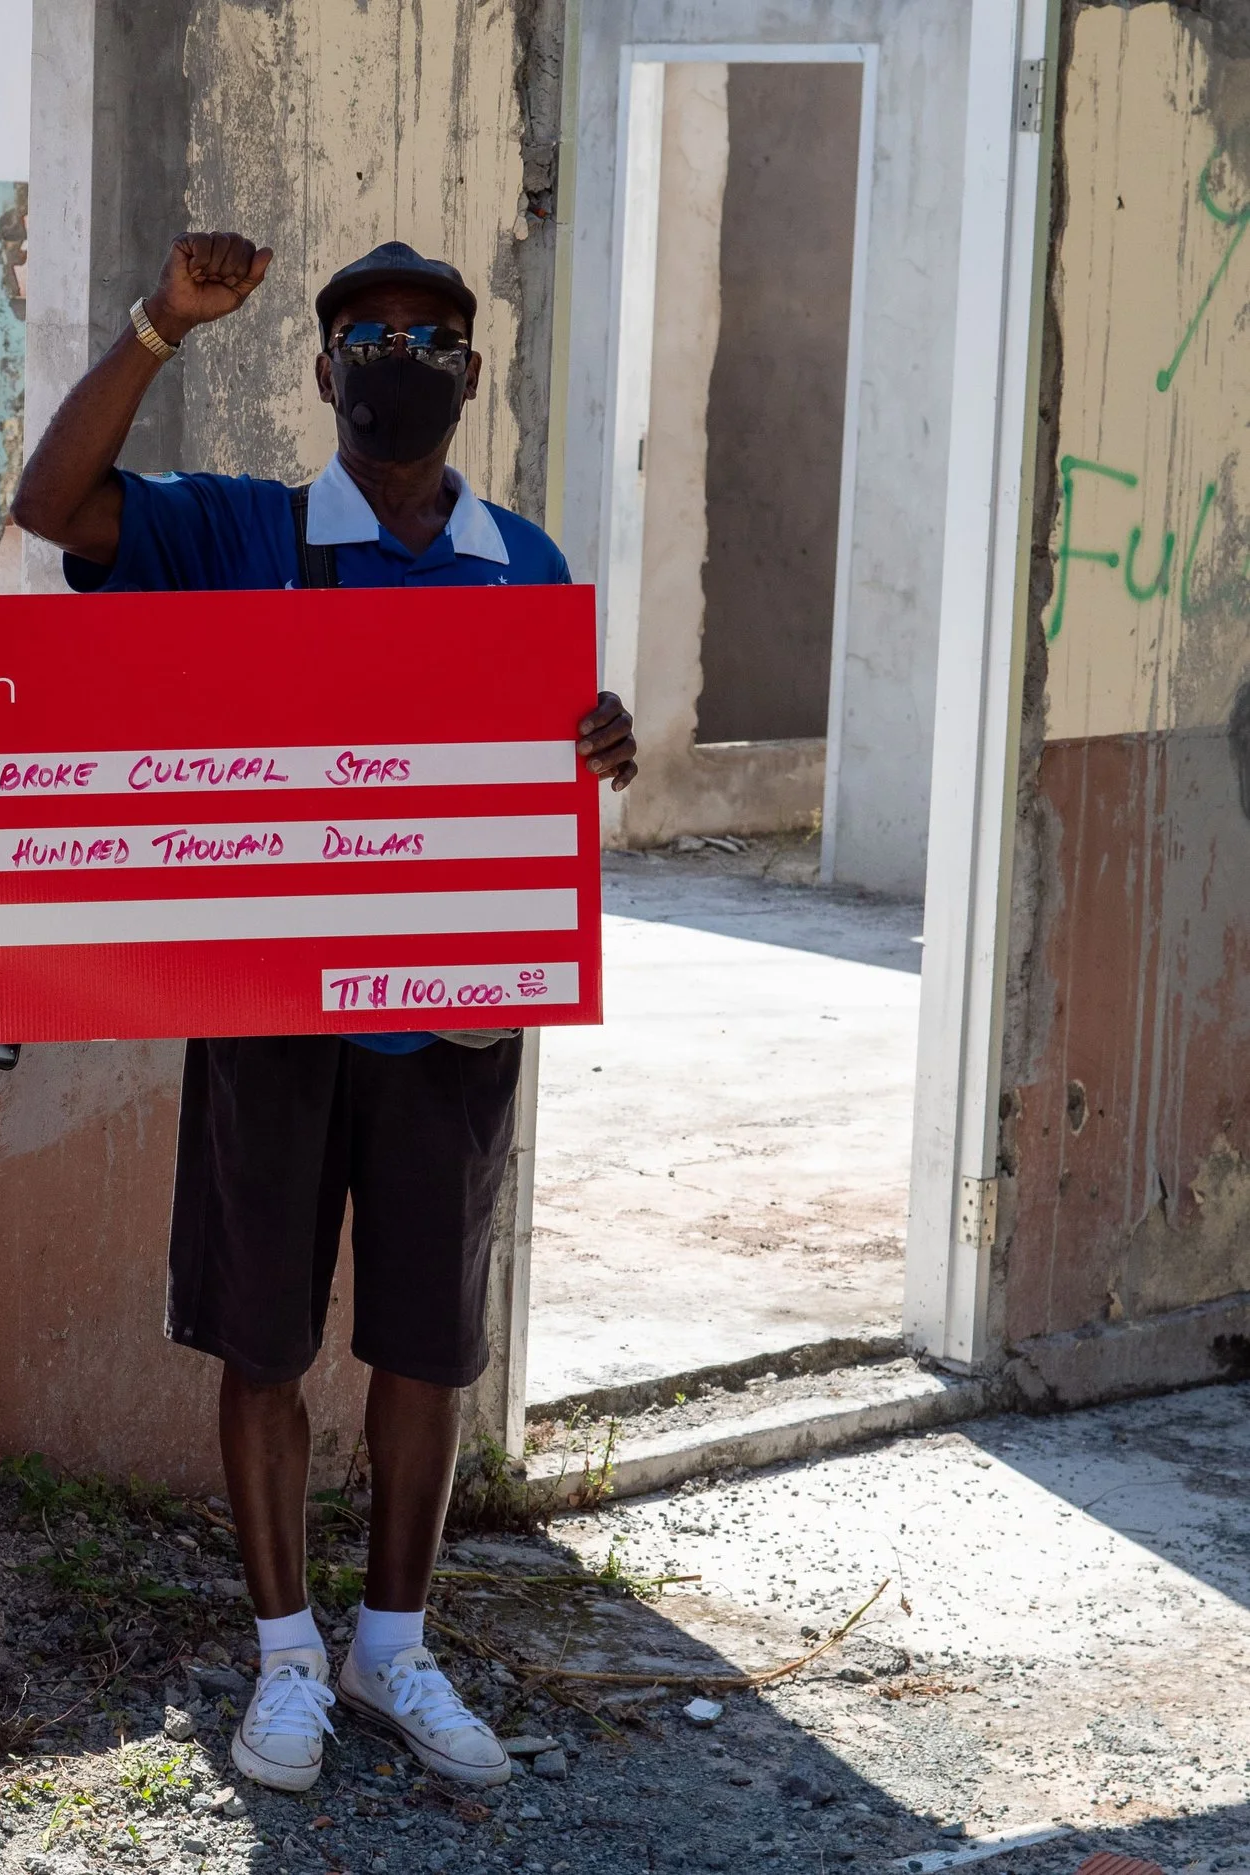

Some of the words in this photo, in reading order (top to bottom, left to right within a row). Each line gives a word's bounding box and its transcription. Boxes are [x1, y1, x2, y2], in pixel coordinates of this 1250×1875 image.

[128, 755, 289, 791] CULTURAL
[324, 750, 411, 786] STARS
[12, 837, 130, 868] HUNDRED
[152, 829, 284, 863] THOUSAND
[322, 826, 424, 860] DOLLARS
